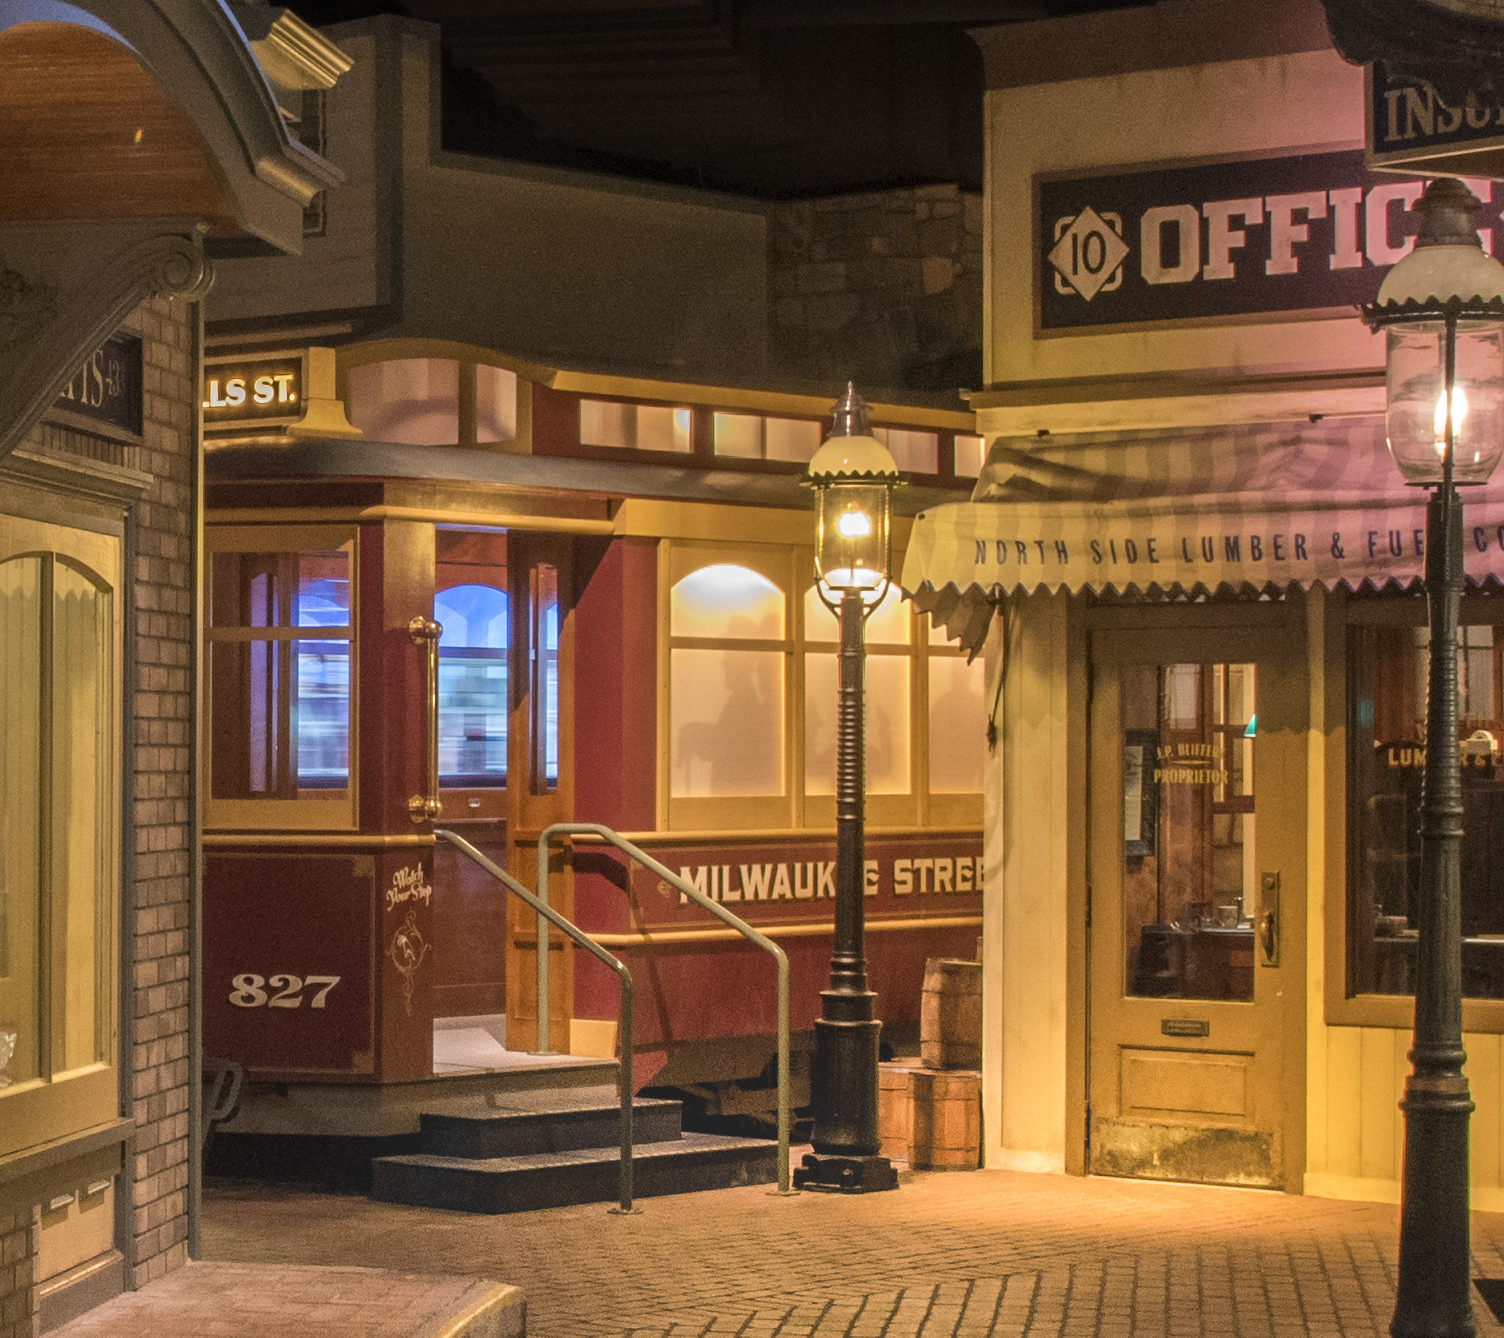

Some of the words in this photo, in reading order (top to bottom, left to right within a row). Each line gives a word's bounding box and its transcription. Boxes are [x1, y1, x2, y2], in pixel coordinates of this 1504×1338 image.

[1071, 229, 1107, 277] 10
[1141, 178, 1492, 285] OFFIC
[203, 377, 247, 408] LS
[253, 374, 296, 405] ST.
[975, 538, 1069, 565] NORTH
[1092, 537, 1159, 564] SIDE
[1182, 532, 1307, 564] LUMBER
[1330, 536, 1344, 560] &
[1368, 528, 1425, 559] FUE
[1388, 748, 1468, 767] LUMR
[1154, 768, 1229, 785] PROPRIETOR
[393, 862, 424, 890] Watch
[679, 860, 879, 905] MILWAUKE
[386, 887, 411, 911] Your
[410, 882, 432, 906] Step
[228, 974, 341, 1009] 827
